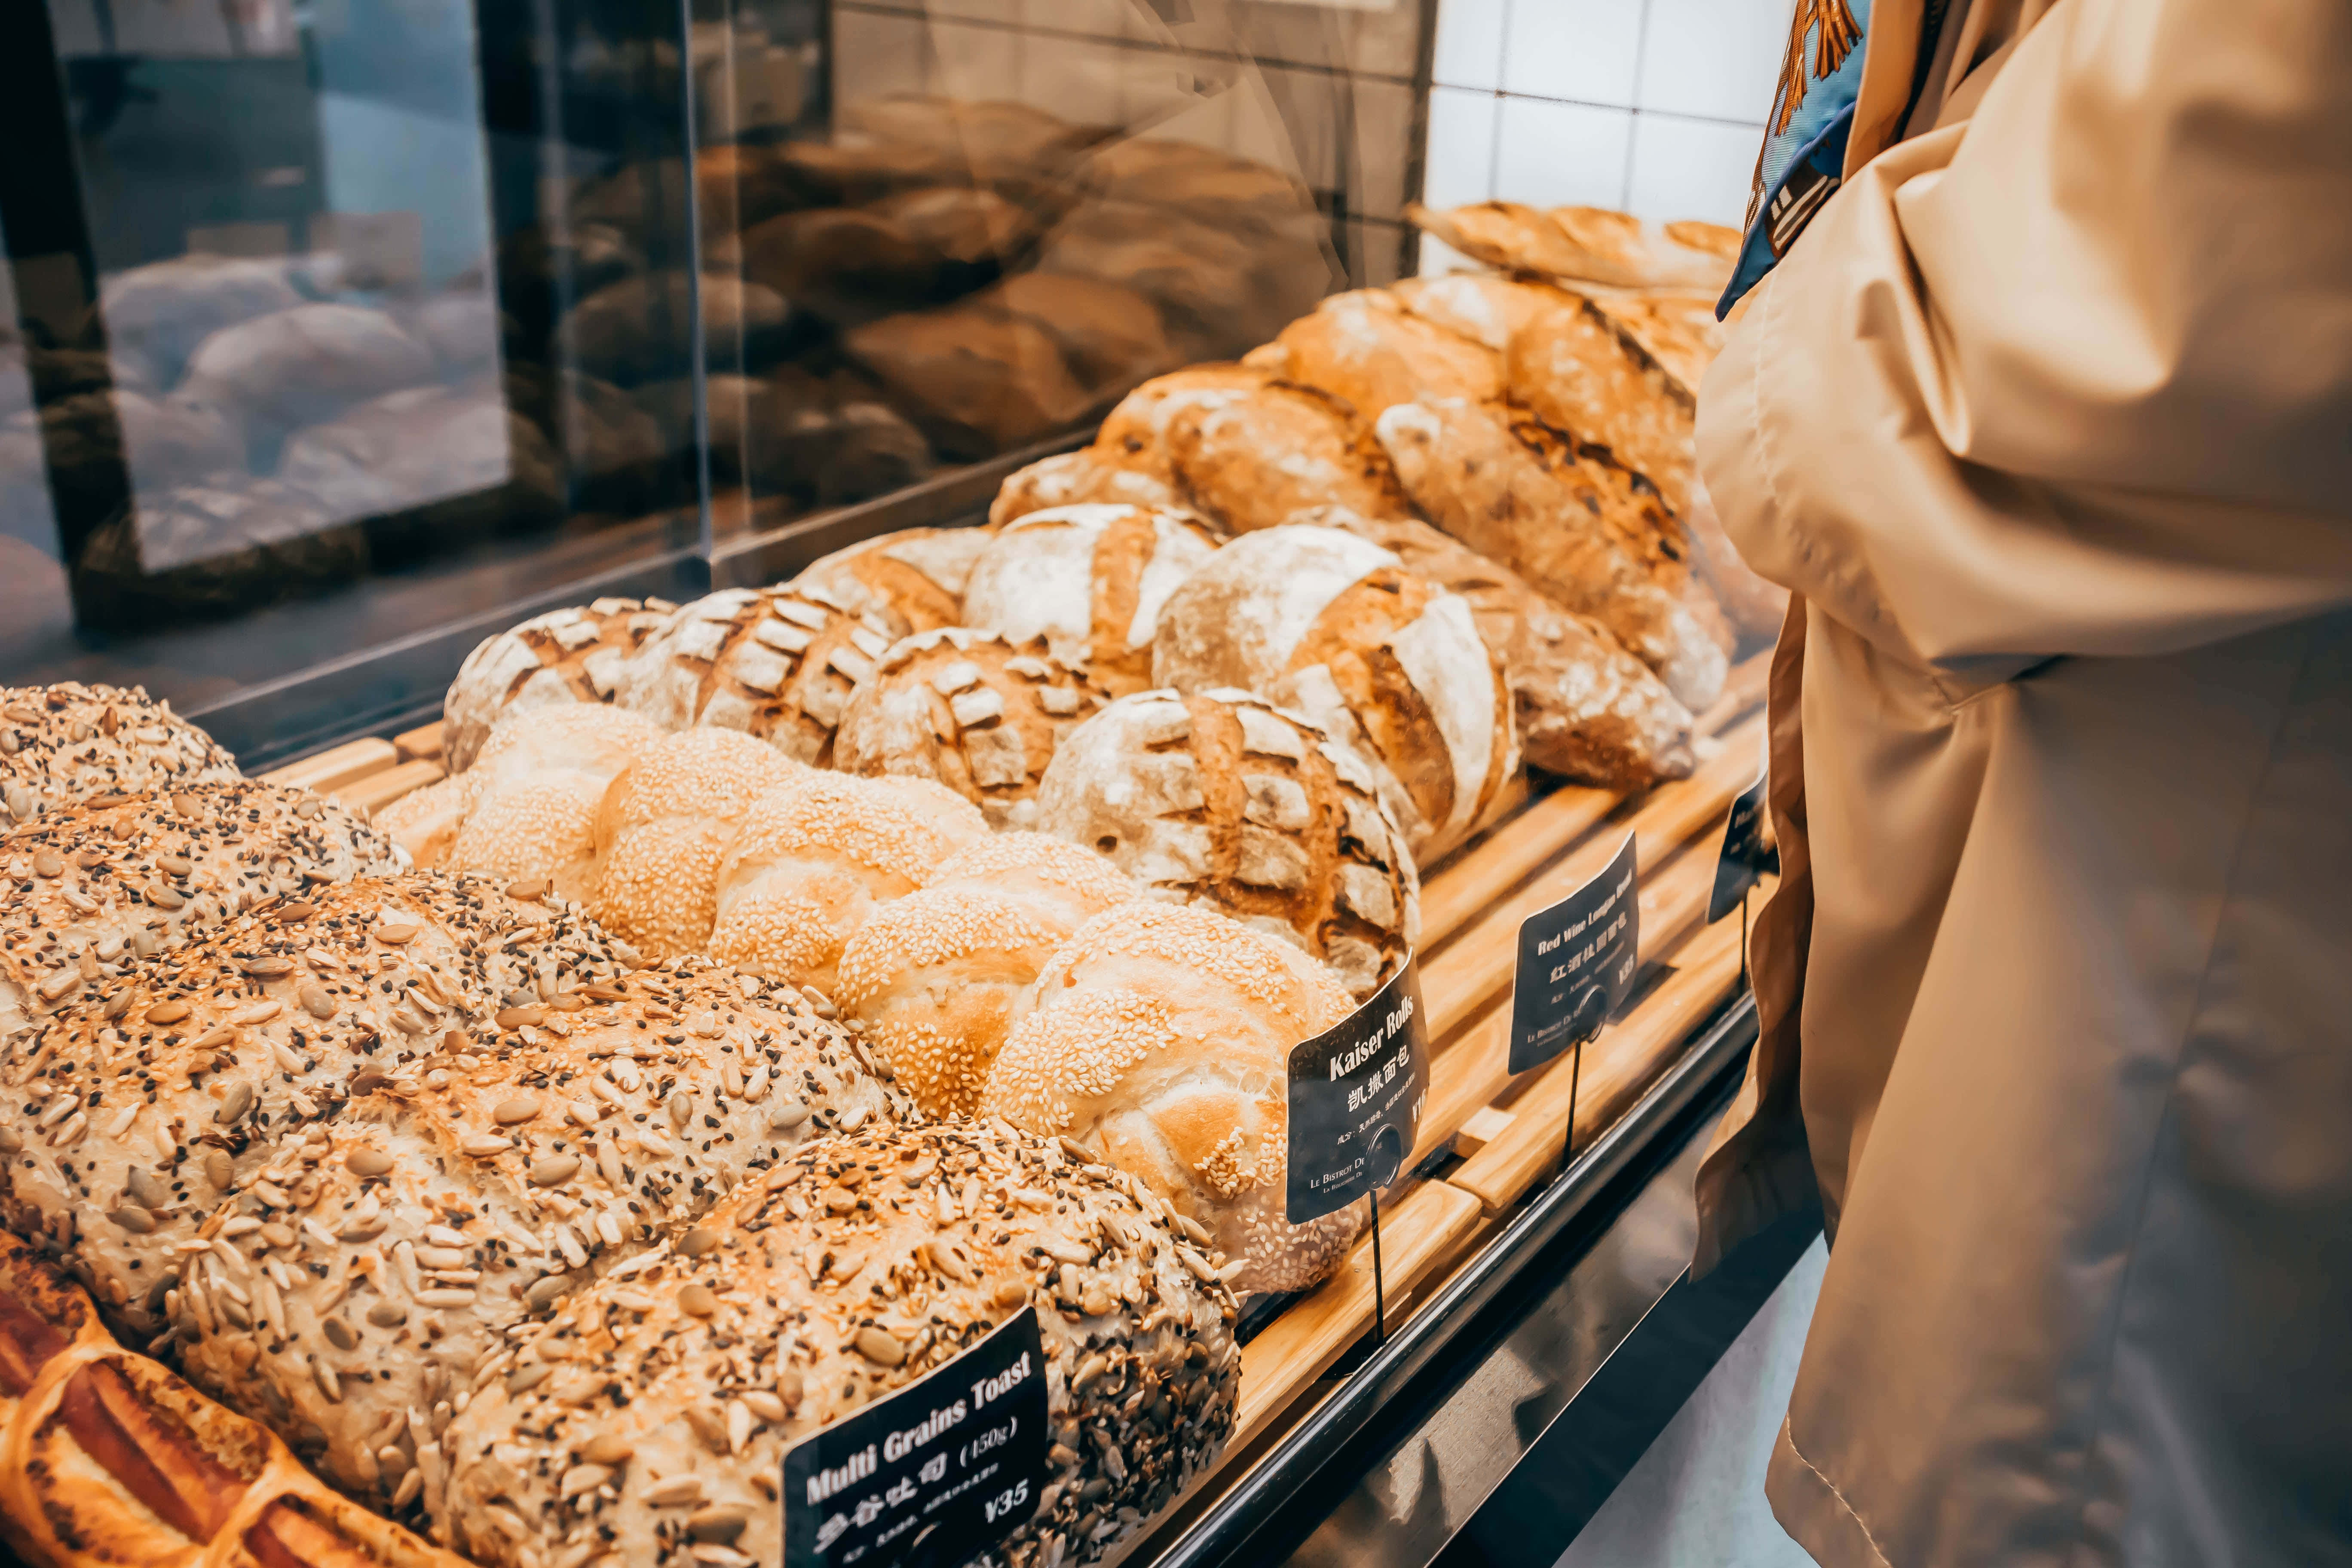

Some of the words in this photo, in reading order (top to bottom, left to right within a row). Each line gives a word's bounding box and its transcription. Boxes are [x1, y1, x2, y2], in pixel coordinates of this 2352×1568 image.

[1538, 932, 1561, 956] Red
[1330, 1028, 1384, 1081] Kaiser
[1386, 996, 1414, 1039] Rolls
[1348, 1044, 1410, 1112] 凯撒面包
[807, 1444, 877, 1504] Multi
[884, 1400, 967, 1462] Grains
[971, 1351, 1031, 1410] Toast
